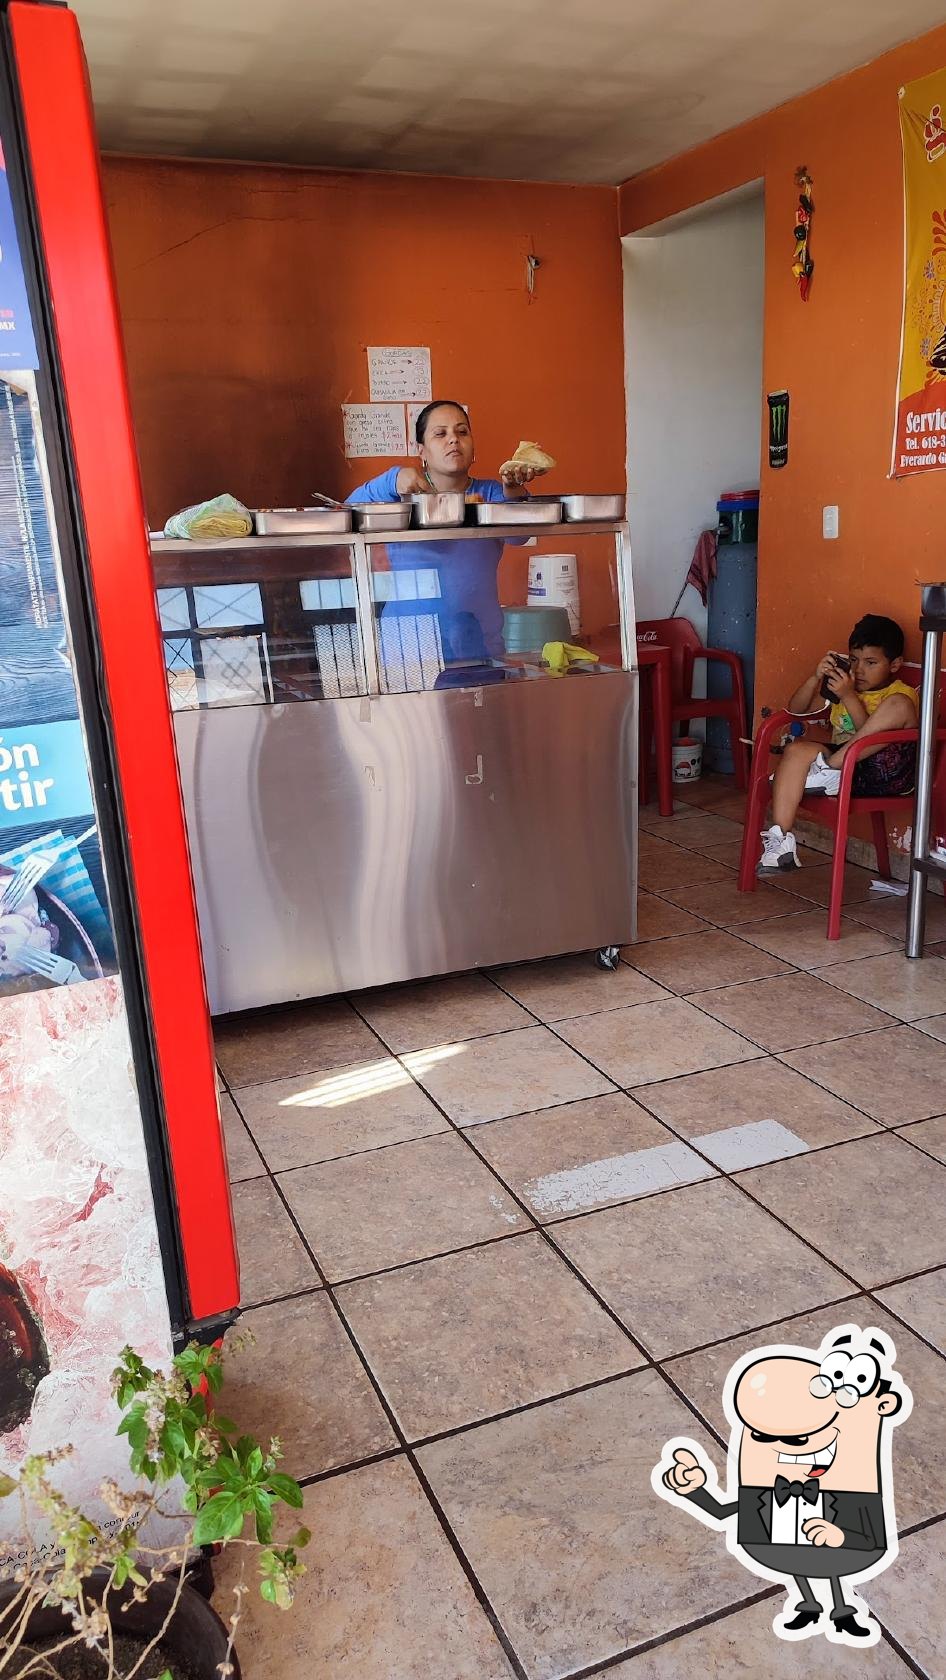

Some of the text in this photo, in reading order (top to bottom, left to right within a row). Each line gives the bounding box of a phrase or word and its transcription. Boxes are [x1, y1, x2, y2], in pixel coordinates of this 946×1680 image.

[905, 434, 946, 450] Tel. 618-3
[900, 452, 937, 468] Everardo
[0, 770, 55, 811] tir
